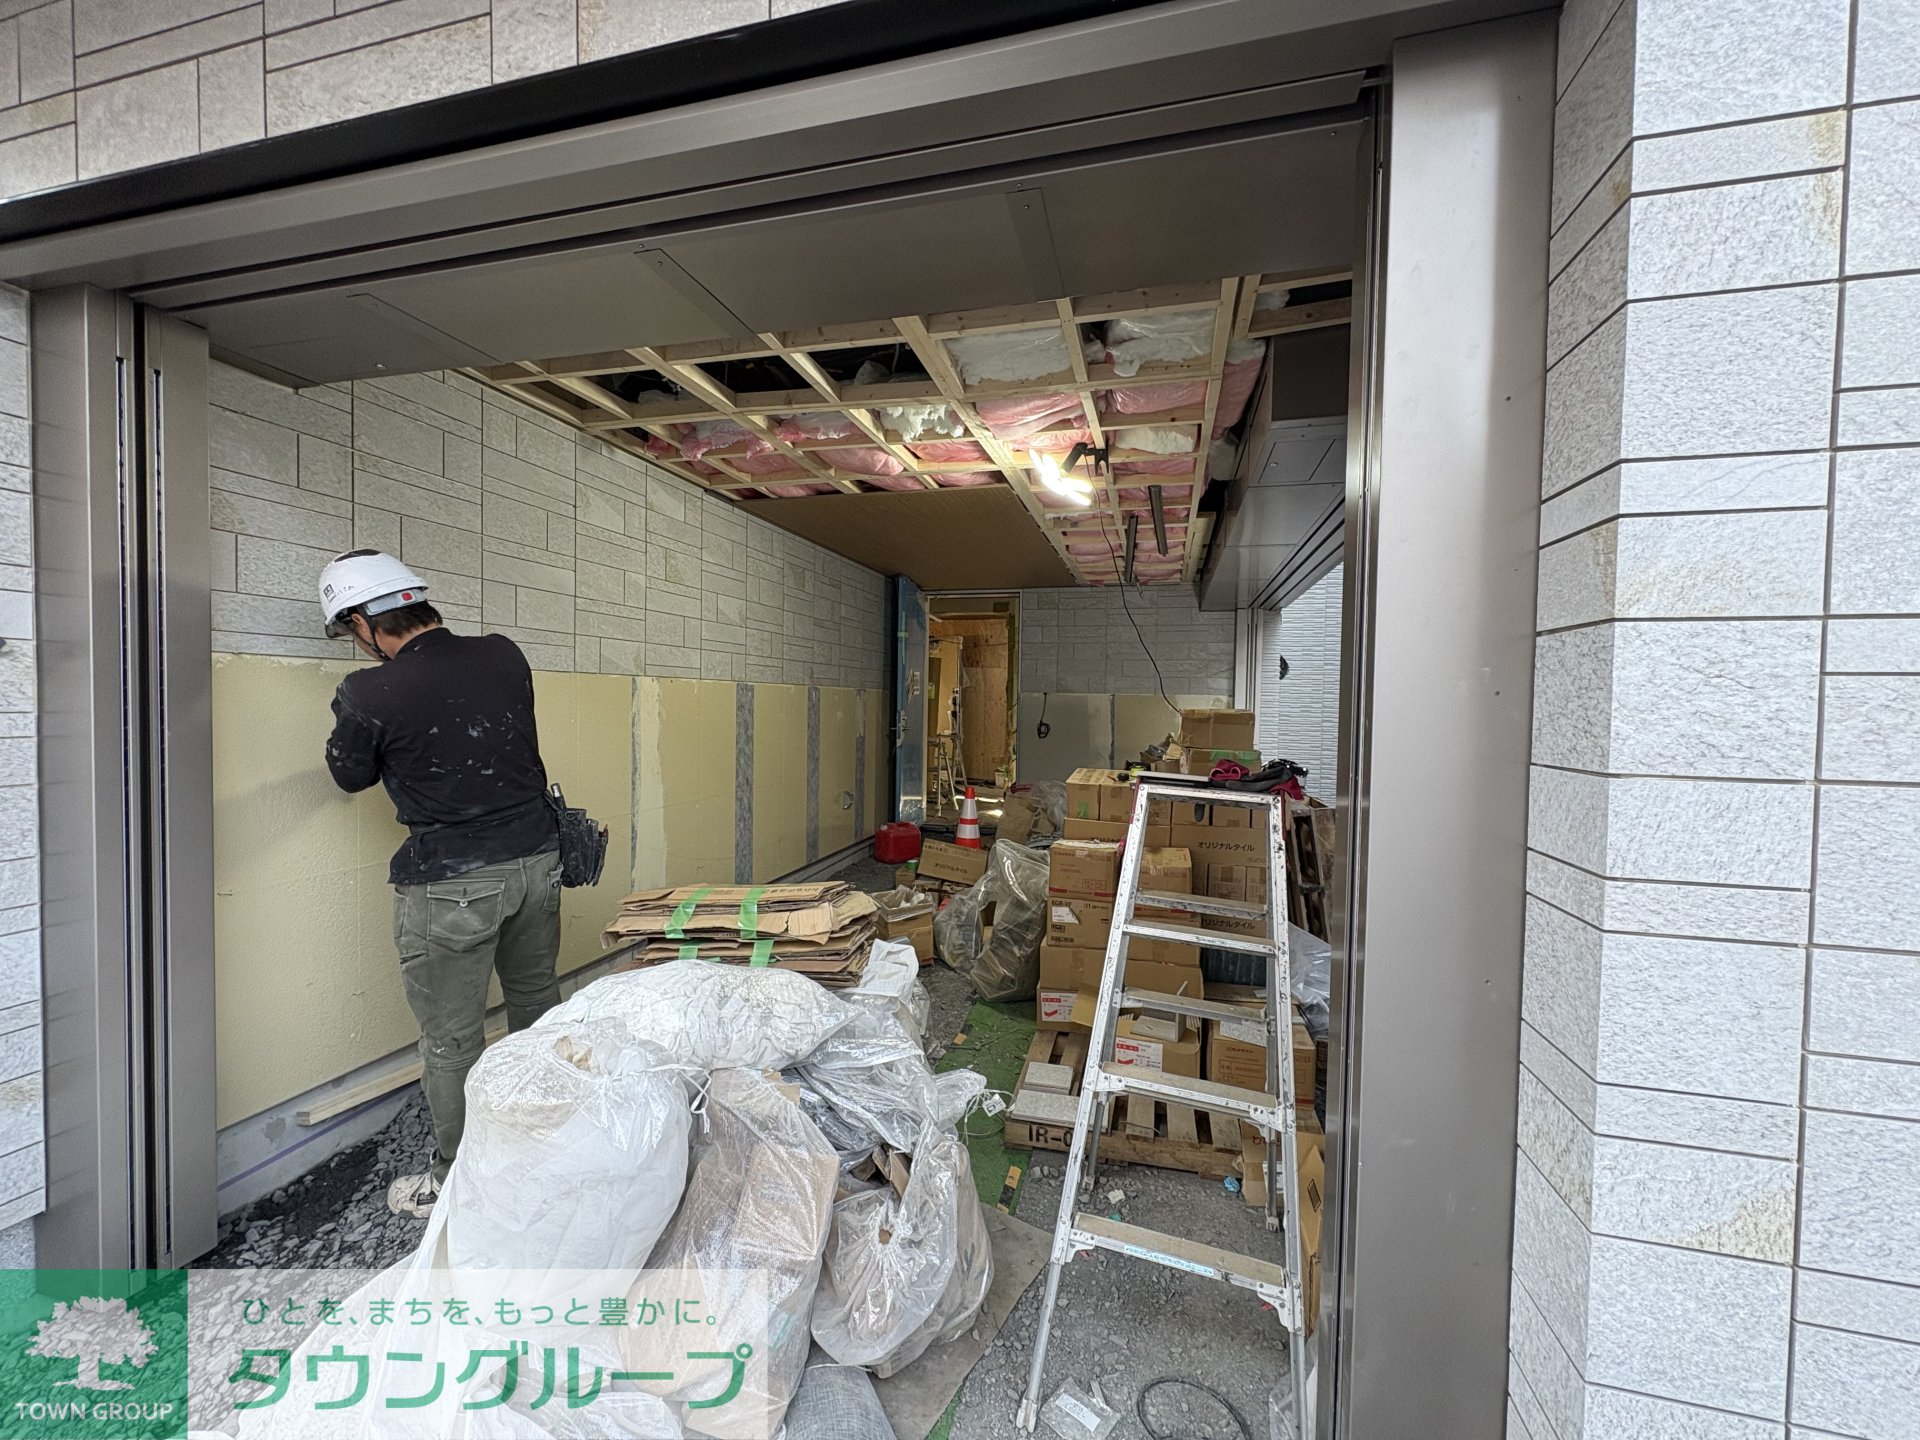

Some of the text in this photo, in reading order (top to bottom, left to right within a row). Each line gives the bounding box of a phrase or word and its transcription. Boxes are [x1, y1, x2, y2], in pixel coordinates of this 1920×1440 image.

[1197, 841, 1255, 852] オリジナルタイル
